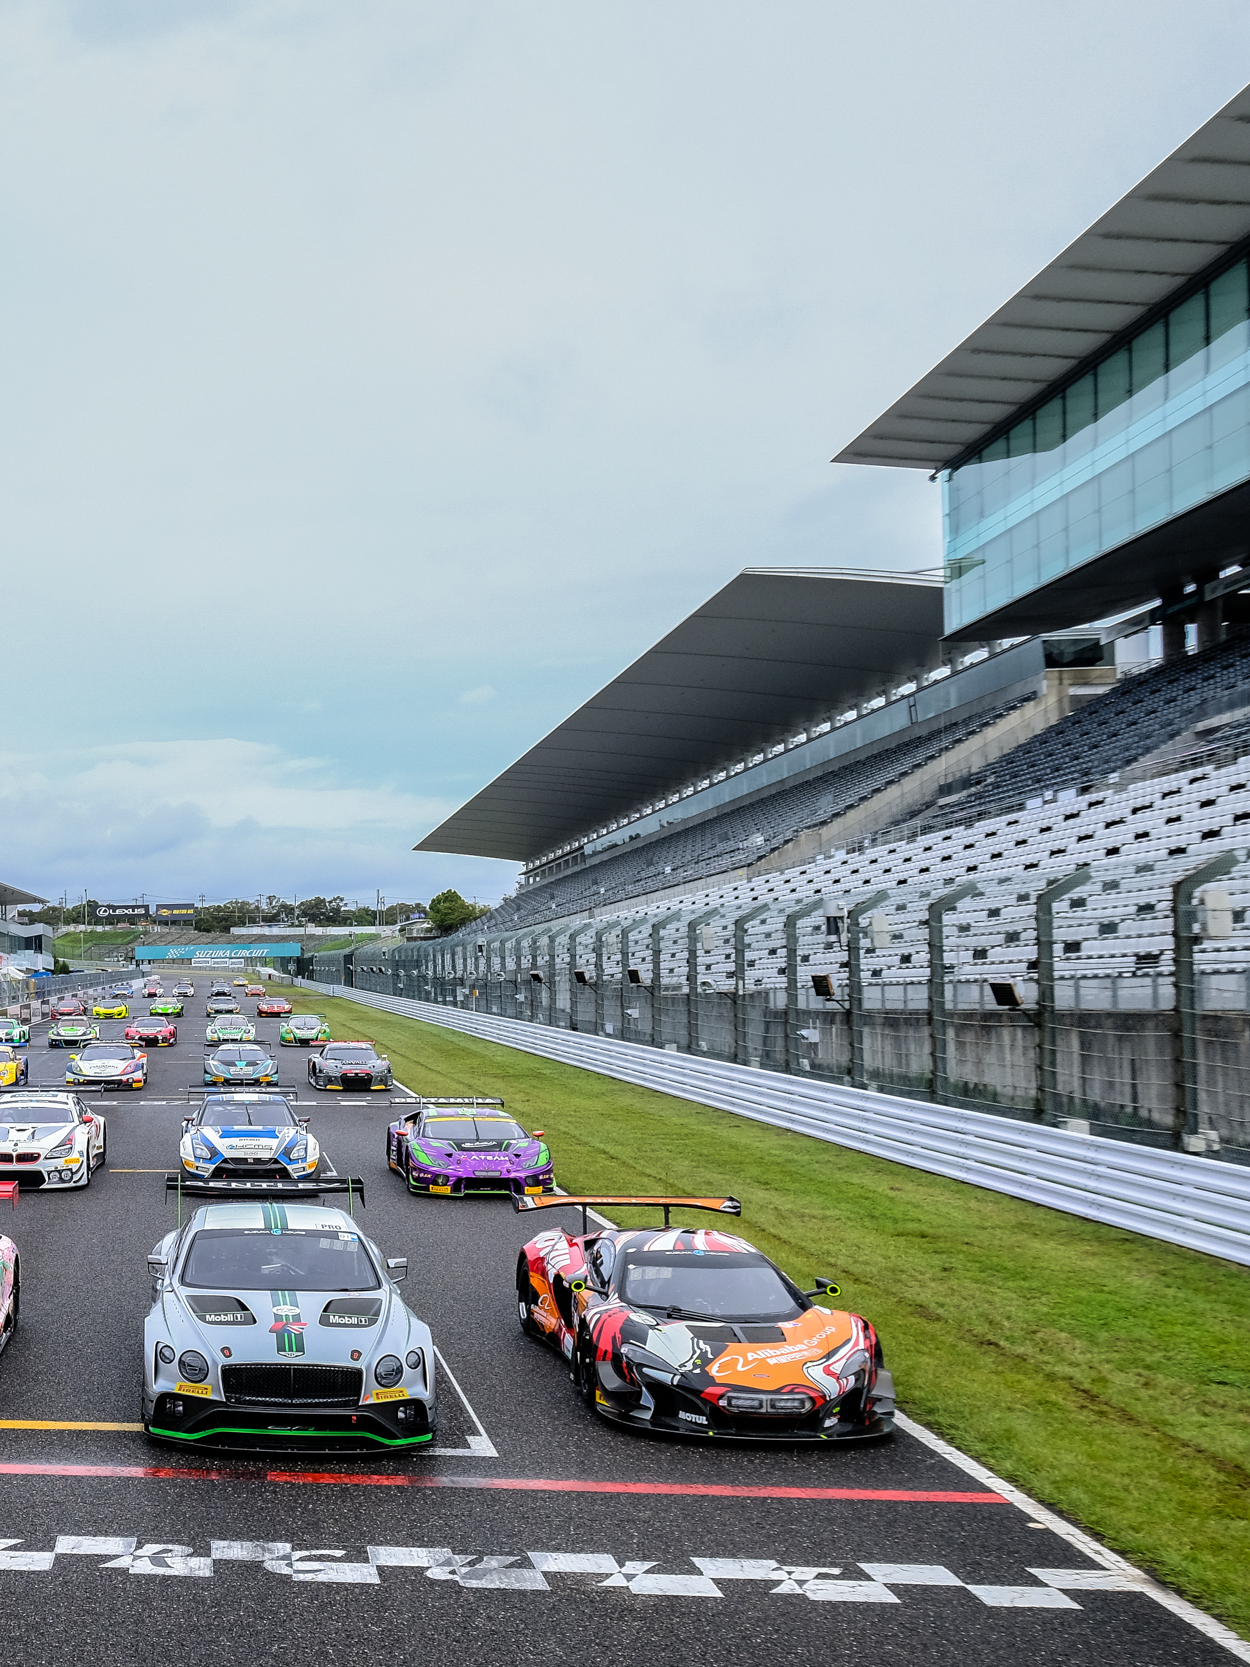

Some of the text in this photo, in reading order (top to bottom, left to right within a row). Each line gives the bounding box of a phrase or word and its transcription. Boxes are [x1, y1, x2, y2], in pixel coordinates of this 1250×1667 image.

[194, 949, 269, 958] SUZUKA CIRCUIT
[205, 1312, 234, 1322] Mobil
[329, 1315, 357, 1325] Mobil
[746, 1325, 836, 1361] Alibaba Group
[177, 1385, 209, 1396] PIRELLI
[374, 1391, 406, 1401] PIRELLI
[678, 1410, 708, 1424] MOTUL
